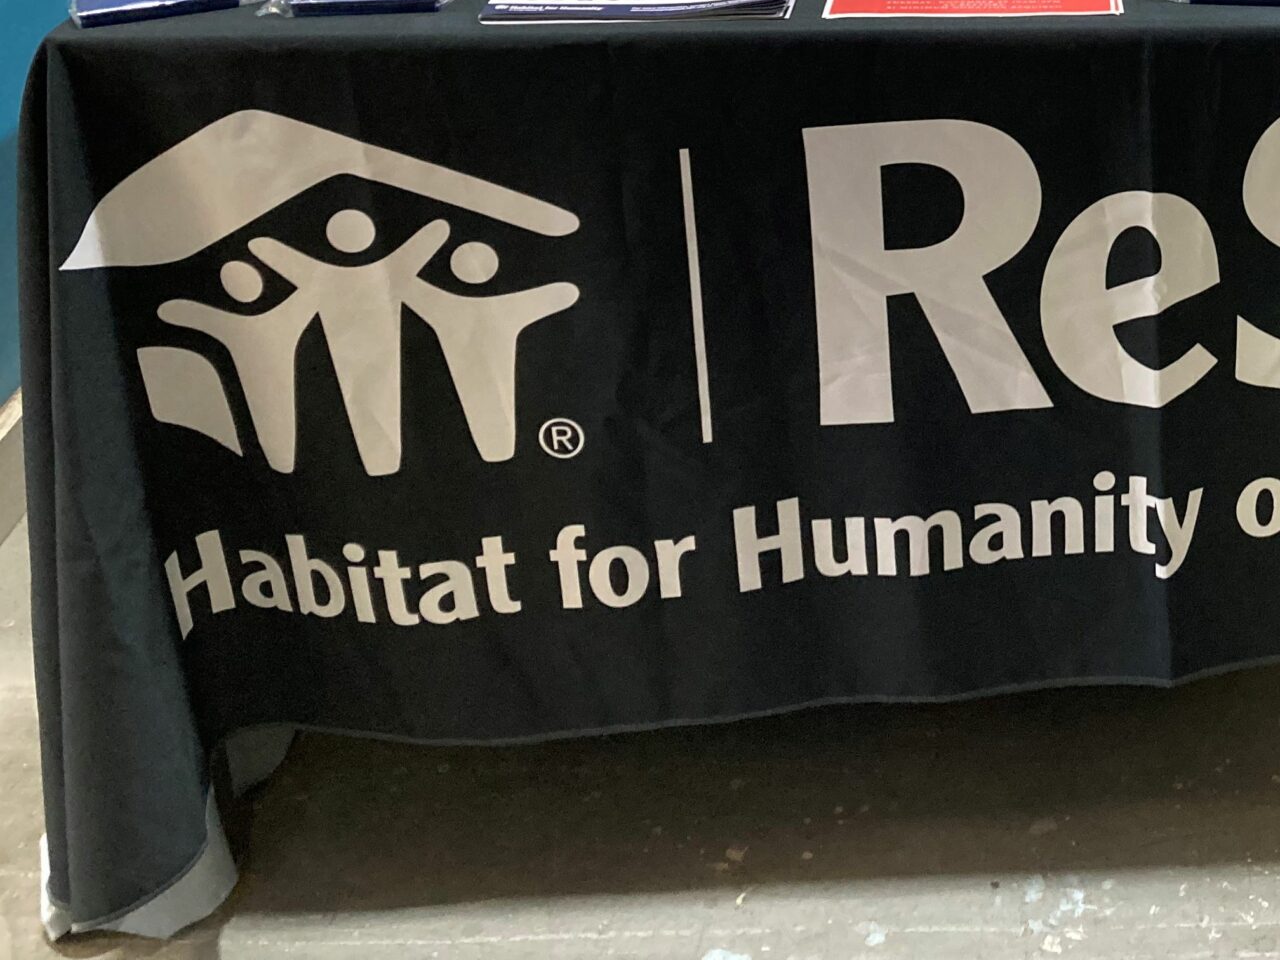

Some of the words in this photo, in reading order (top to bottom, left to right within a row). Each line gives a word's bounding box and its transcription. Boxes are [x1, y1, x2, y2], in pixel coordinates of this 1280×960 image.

[164, 529, 522, 641] Habitat
[549, 523, 696, 610] for
[732, 469, 1204, 595] Humanity
